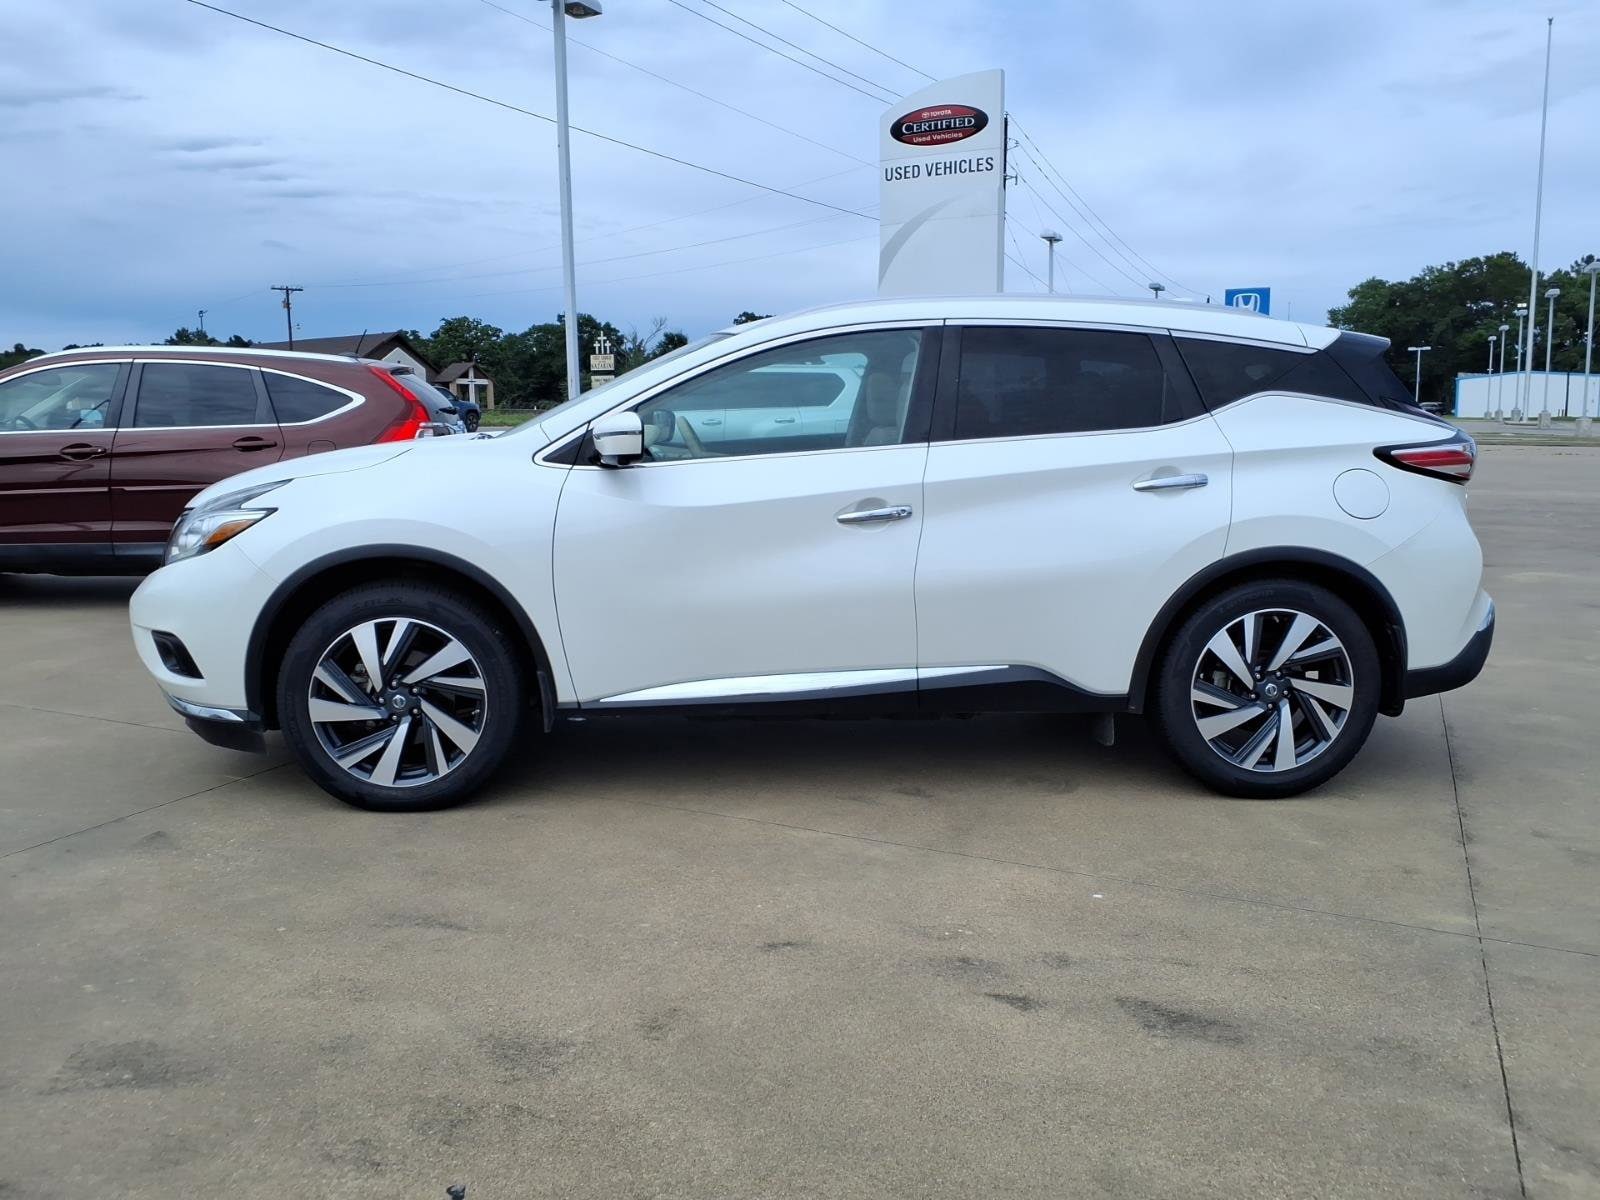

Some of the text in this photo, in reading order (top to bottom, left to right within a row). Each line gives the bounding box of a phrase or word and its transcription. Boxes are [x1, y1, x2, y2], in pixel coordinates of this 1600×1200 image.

[930, 109, 951, 117] TOYOTA
[932, 132, 963, 140] Vehicles
[885, 157, 994, 181] USED VEHICLES
